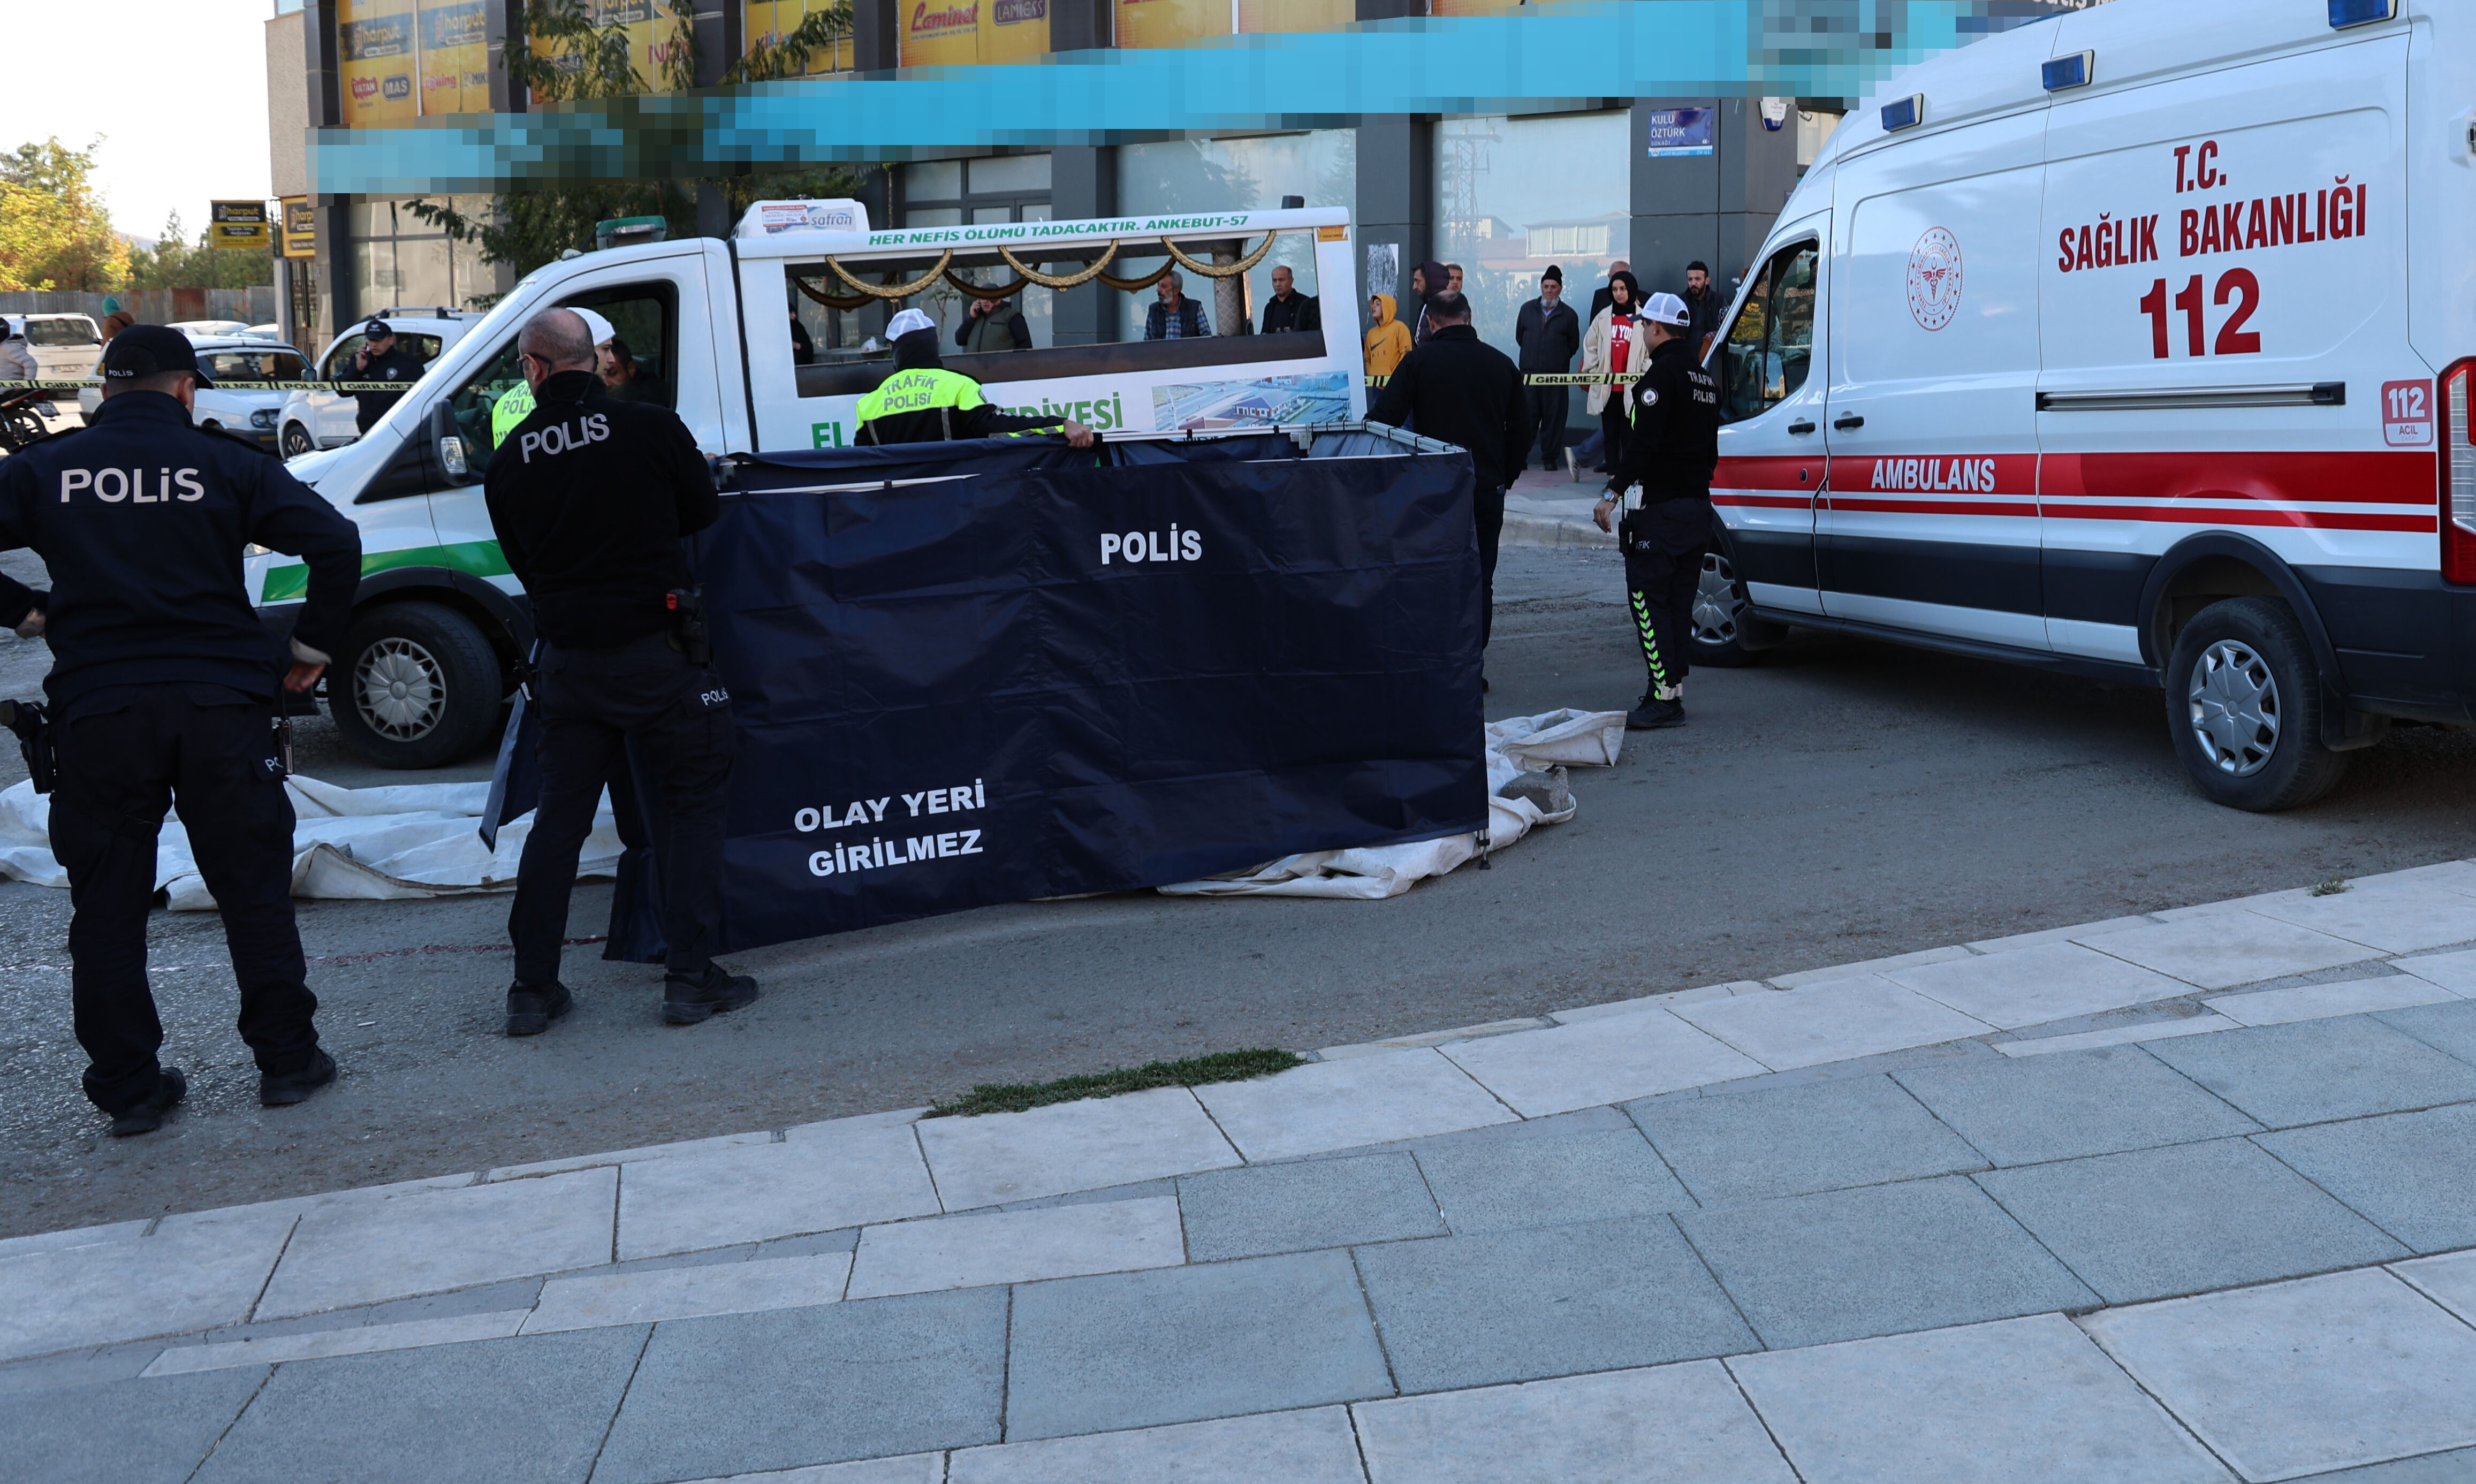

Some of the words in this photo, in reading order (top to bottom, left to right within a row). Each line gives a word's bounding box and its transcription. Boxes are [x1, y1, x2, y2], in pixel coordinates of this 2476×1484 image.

[362, 22, 400, 45] harput
[444, 9, 485, 32] harput
[353, 81, 375, 93] VATAN
[384, 80, 408, 95] MAS
[1651, 114, 1675, 125] KULU
[1651, 126, 1685, 139] ÖZTÜRK
[2174, 140, 2227, 194] T.C.
[226, 207, 260, 216] harput
[810, 213, 852, 226] safran
[2058, 211, 2159, 273] SAĞLIK
[2179, 173, 2366, 257] BAKANLIĞI
[868, 234, 905, 246] HER
[909, 230, 960, 243] NEFİS
[964, 225, 1026, 240] ÖLÜMÜ
[1031, 220, 1141, 237] TADACAKTIR.
[1144, 215, 1249, 230] ANKEBUT-57
[2140, 267, 2261, 359] 112
[2388, 386, 2426, 418] 112
[811, 421, 855, 450] EL
[1871, 458, 1996, 492] AMBULANS
[1100, 522, 1203, 565] POLİS
[794, 796, 891, 833] OLAY
[901, 778, 986, 818] YERİ
[808, 828, 984, 877] GİRİLMEZ
